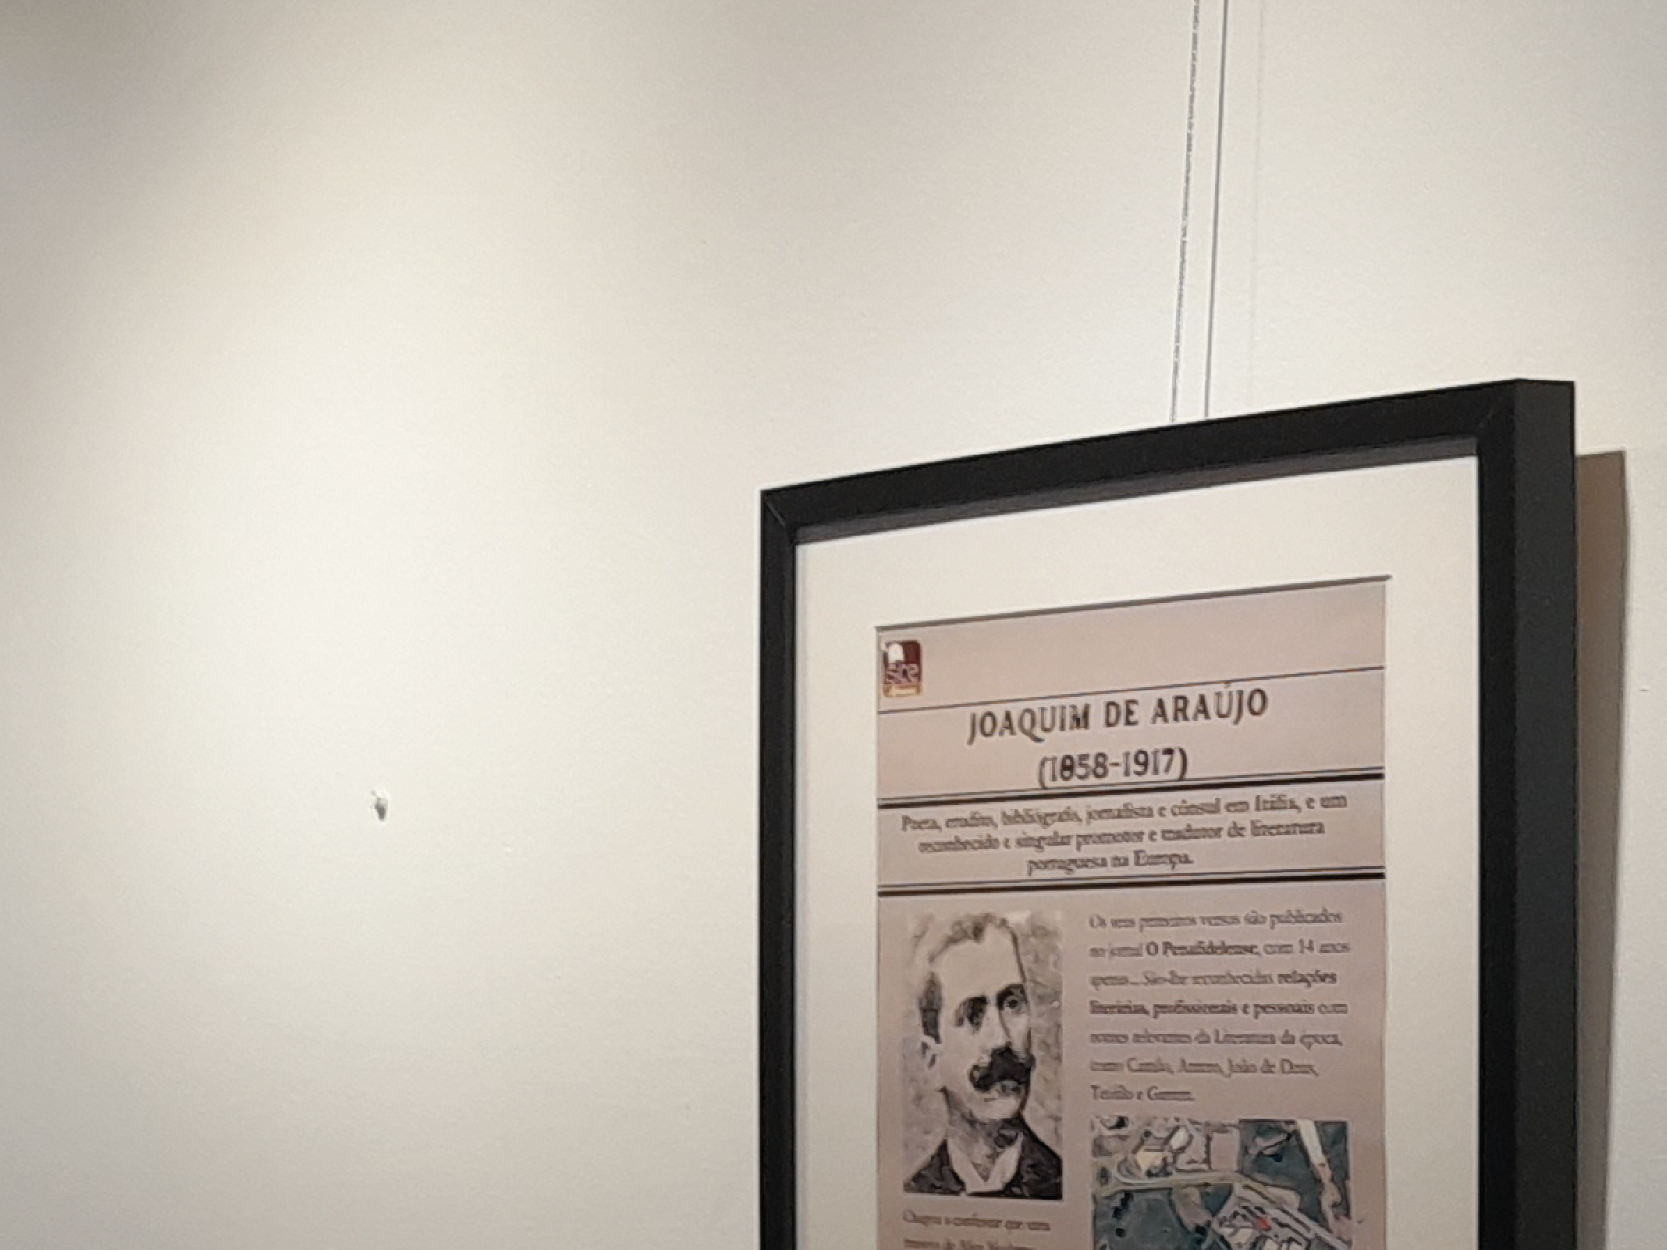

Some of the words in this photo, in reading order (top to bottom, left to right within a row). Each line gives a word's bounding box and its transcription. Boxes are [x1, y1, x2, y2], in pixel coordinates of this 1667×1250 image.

[967, 701, 1090, 745] JOAQUIM
[1104, 699, 1141, 728] DE
[1152, 684, 1269, 725] ARAÚJO
[1038, 747, 1188, 789] (1858-1917)
[1227, 822, 1246, 837] de
[1146, 941, 1158, 956] O
